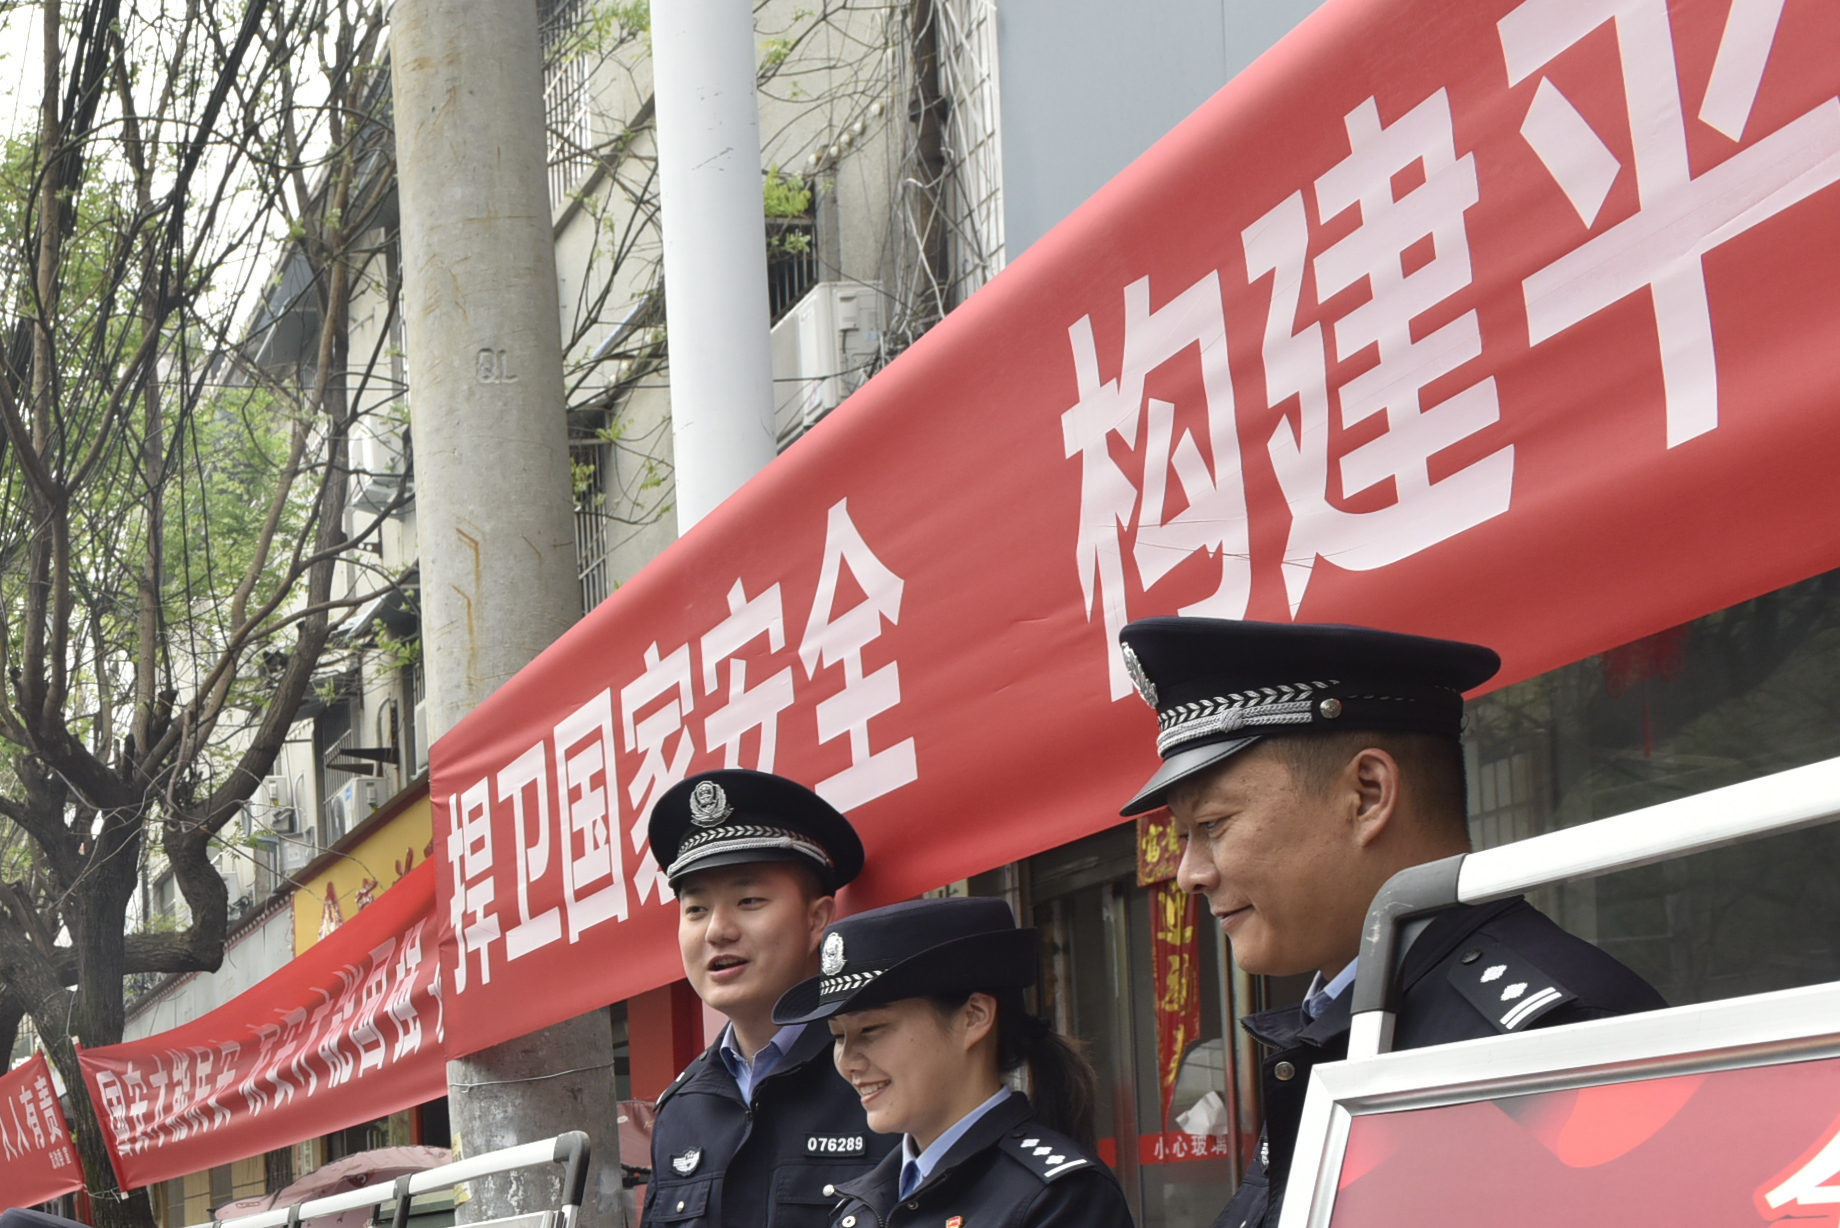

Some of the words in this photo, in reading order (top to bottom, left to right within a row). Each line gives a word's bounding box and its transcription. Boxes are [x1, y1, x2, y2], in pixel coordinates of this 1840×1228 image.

[447, 497, 918, 994] 捍卫国家安全
[1062, 0, 1840, 703] 构建平
[807, 1136, 864, 1152] 076289
[1153, 1135, 1228, 1159] 小心玻璃
